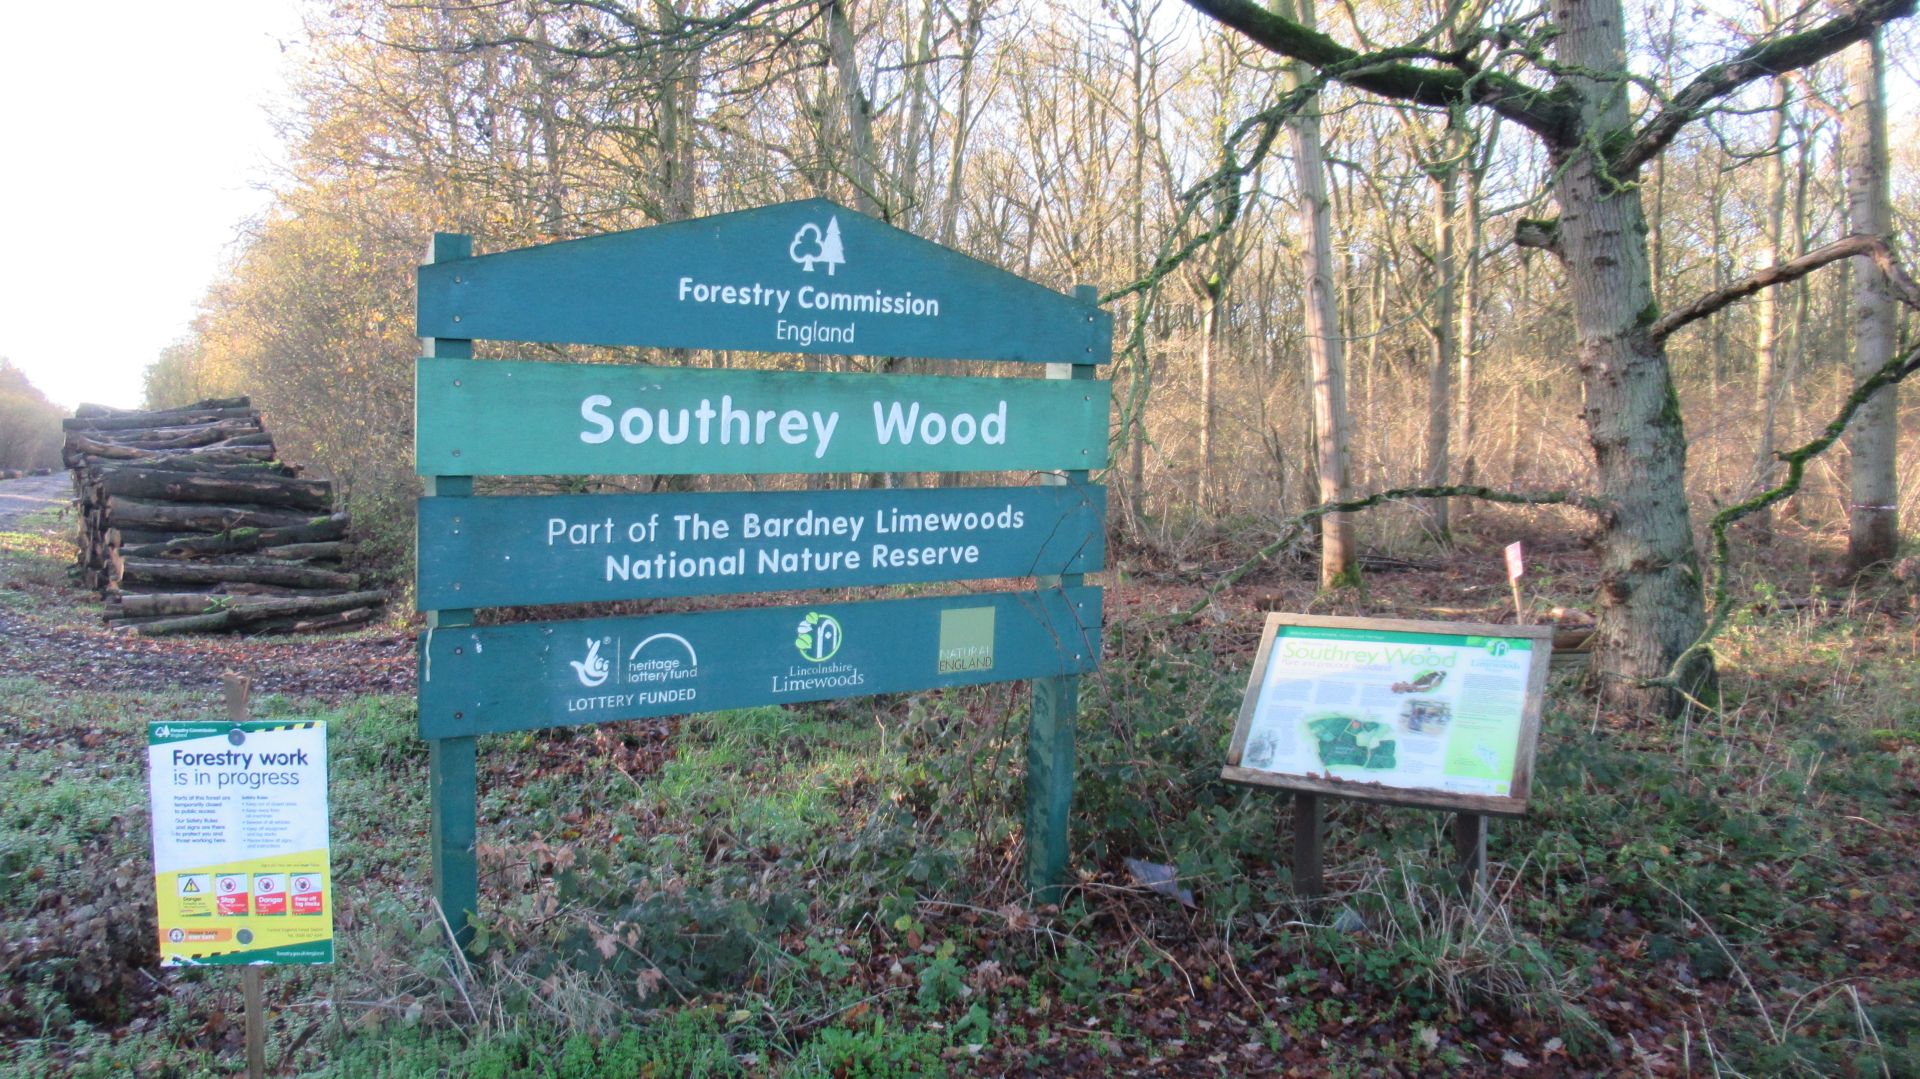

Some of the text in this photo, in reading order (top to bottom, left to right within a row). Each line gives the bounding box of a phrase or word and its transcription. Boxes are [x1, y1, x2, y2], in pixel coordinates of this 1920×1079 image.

[679, 276, 940, 317] Forestry Commission
[776, 318, 856, 347] England
[580, 393, 1008, 460] Southrey Wood
[547, 504, 1026, 546] Part of The Bardney Limewoods
[605, 543, 981, 582] National Nature Reserve
[940, 645, 989, 659] NATURAL
[1283, 641, 1457, 668] Southrey Wood
[628, 667, 698, 683] lottery fund
[629, 659, 680, 672] heritage
[789, 662, 853, 677] Lincolnshire
[940, 657, 992, 672] ENGLAND
[772, 668, 865, 693] Limewoods
[568, 688, 697, 712] LOTTERY FUNDED
[173, 748, 309, 770] Forestry work
[173, 769, 300, 790] is in progress
[258, 896, 283, 904] Danger
